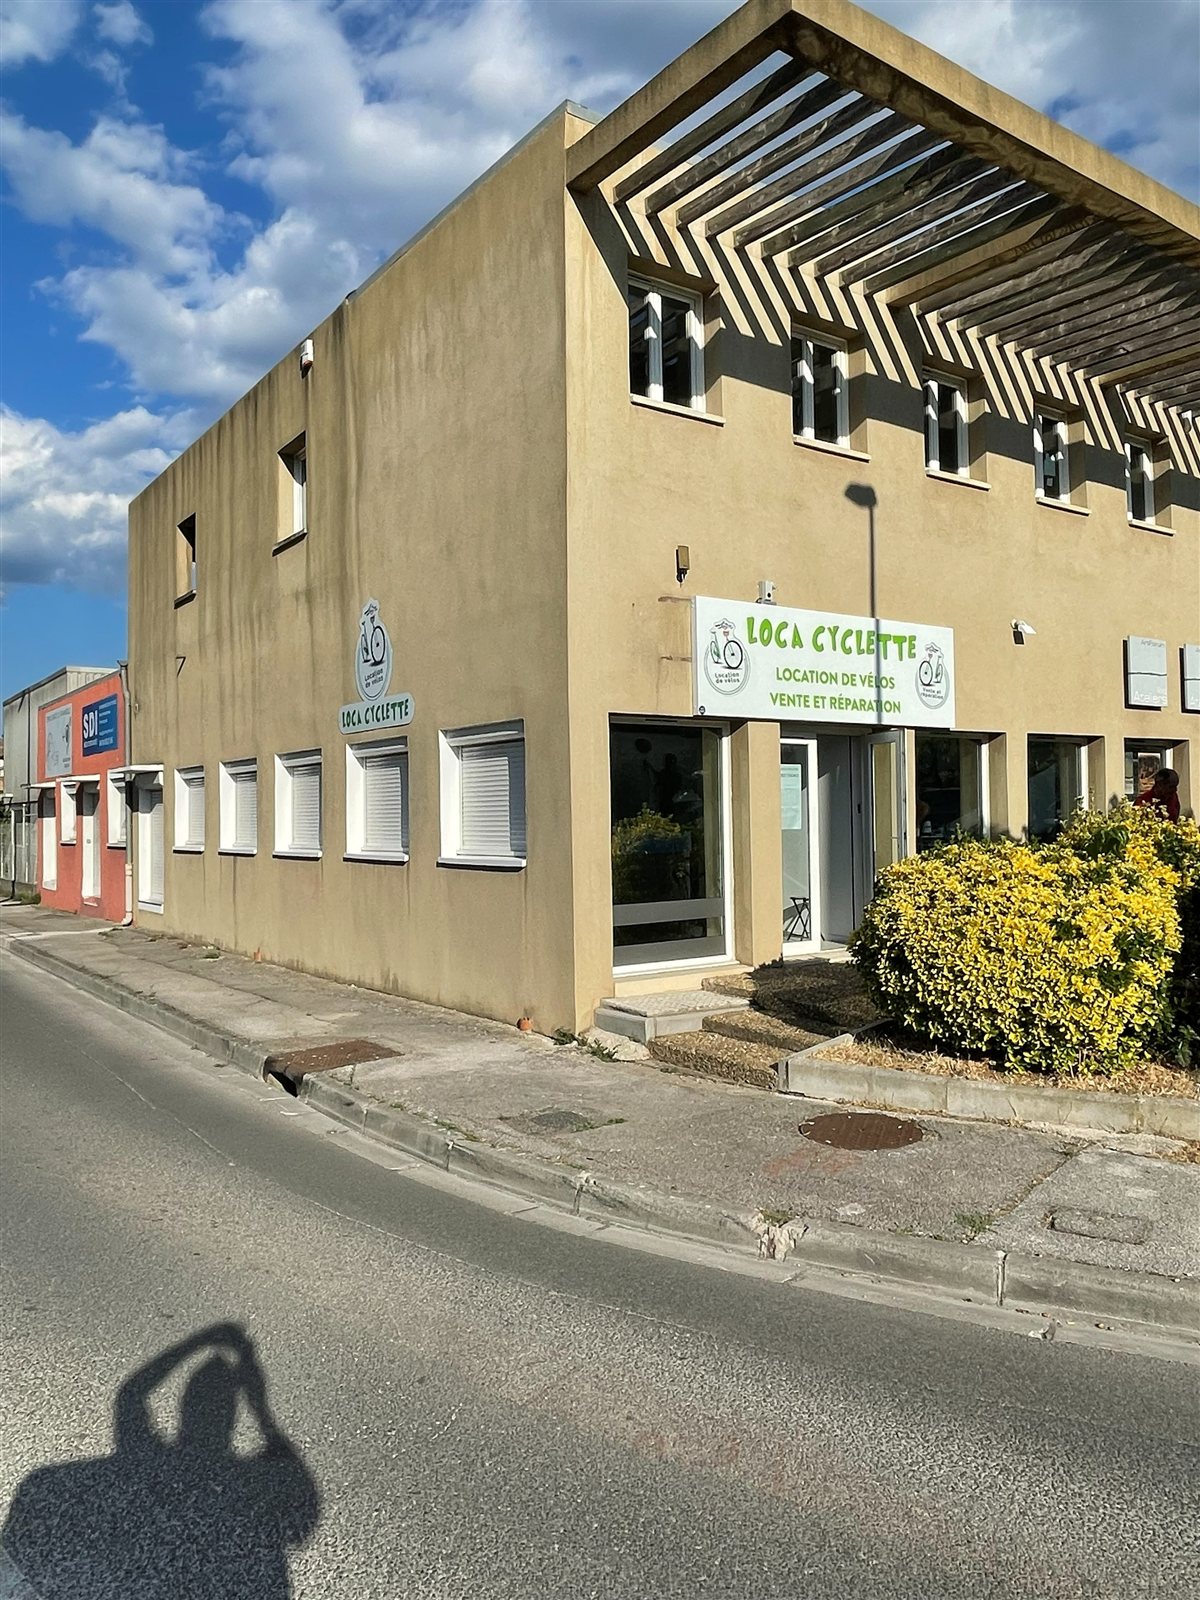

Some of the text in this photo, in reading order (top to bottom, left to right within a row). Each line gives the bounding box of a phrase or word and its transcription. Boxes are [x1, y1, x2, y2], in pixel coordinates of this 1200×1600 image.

[746, 616, 917, 661] LOCA CYCLETTE
[776, 667, 895, 690] LOCATION DE VÉLOS
[342, 698, 409, 728] LOCA CYCLETTE
[769, 692, 901, 713] VENTE ET RÉPARATION
[83, 710, 98, 739] SDI
